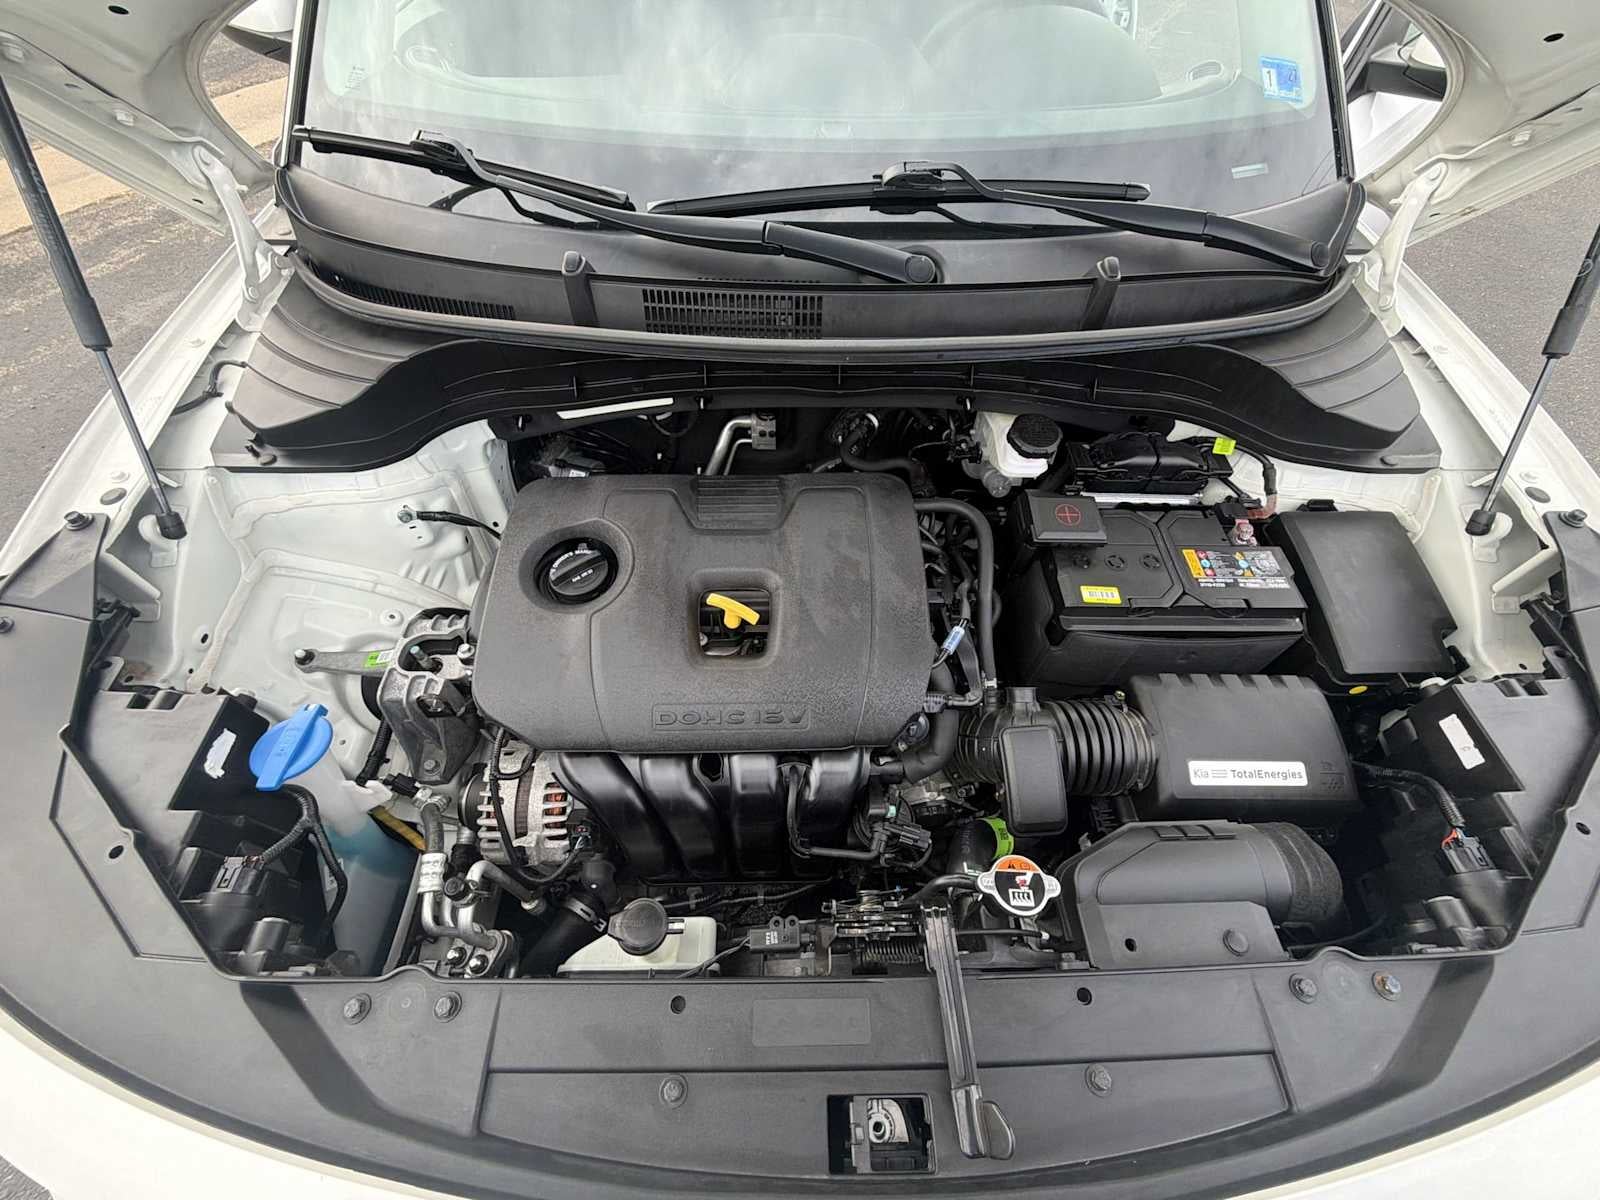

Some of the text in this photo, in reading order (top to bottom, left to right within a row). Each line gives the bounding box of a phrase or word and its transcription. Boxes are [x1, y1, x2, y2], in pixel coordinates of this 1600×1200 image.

[655, 708, 807, 725] DOHC 16V
[1193, 769, 1304, 780] Kia TotalEnergies
